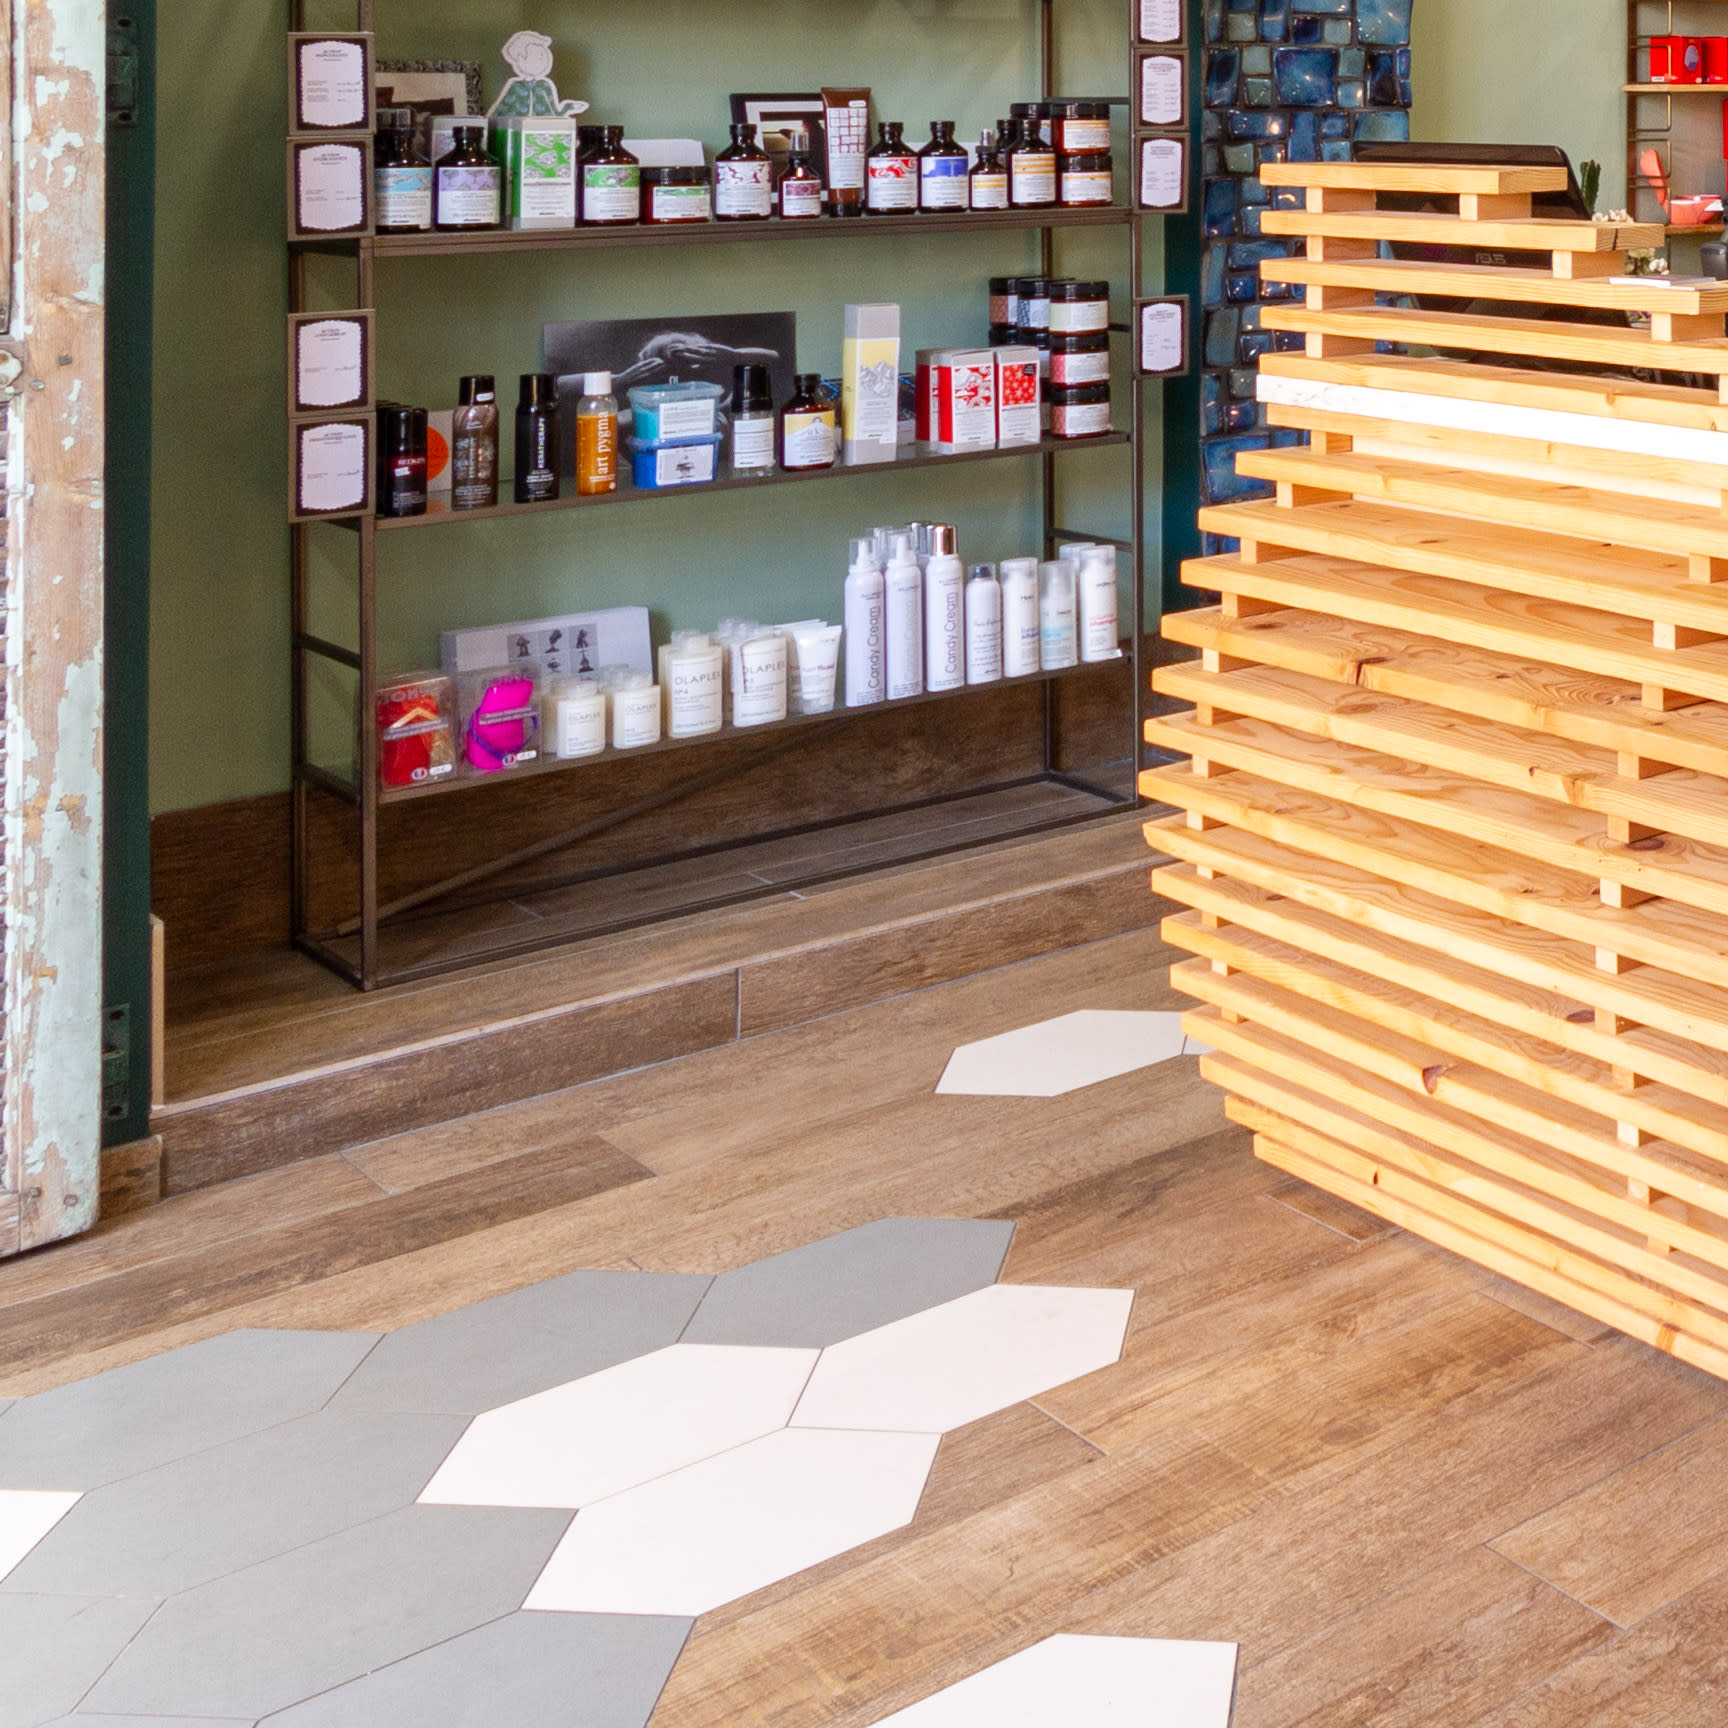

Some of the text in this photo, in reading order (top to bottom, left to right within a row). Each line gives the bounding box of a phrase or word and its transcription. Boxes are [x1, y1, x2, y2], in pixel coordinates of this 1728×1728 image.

[596, 411, 612, 475] art pygma
[867, 607, 882, 690] Candy Cream
[944, 591, 959, 674] Candy Cream
